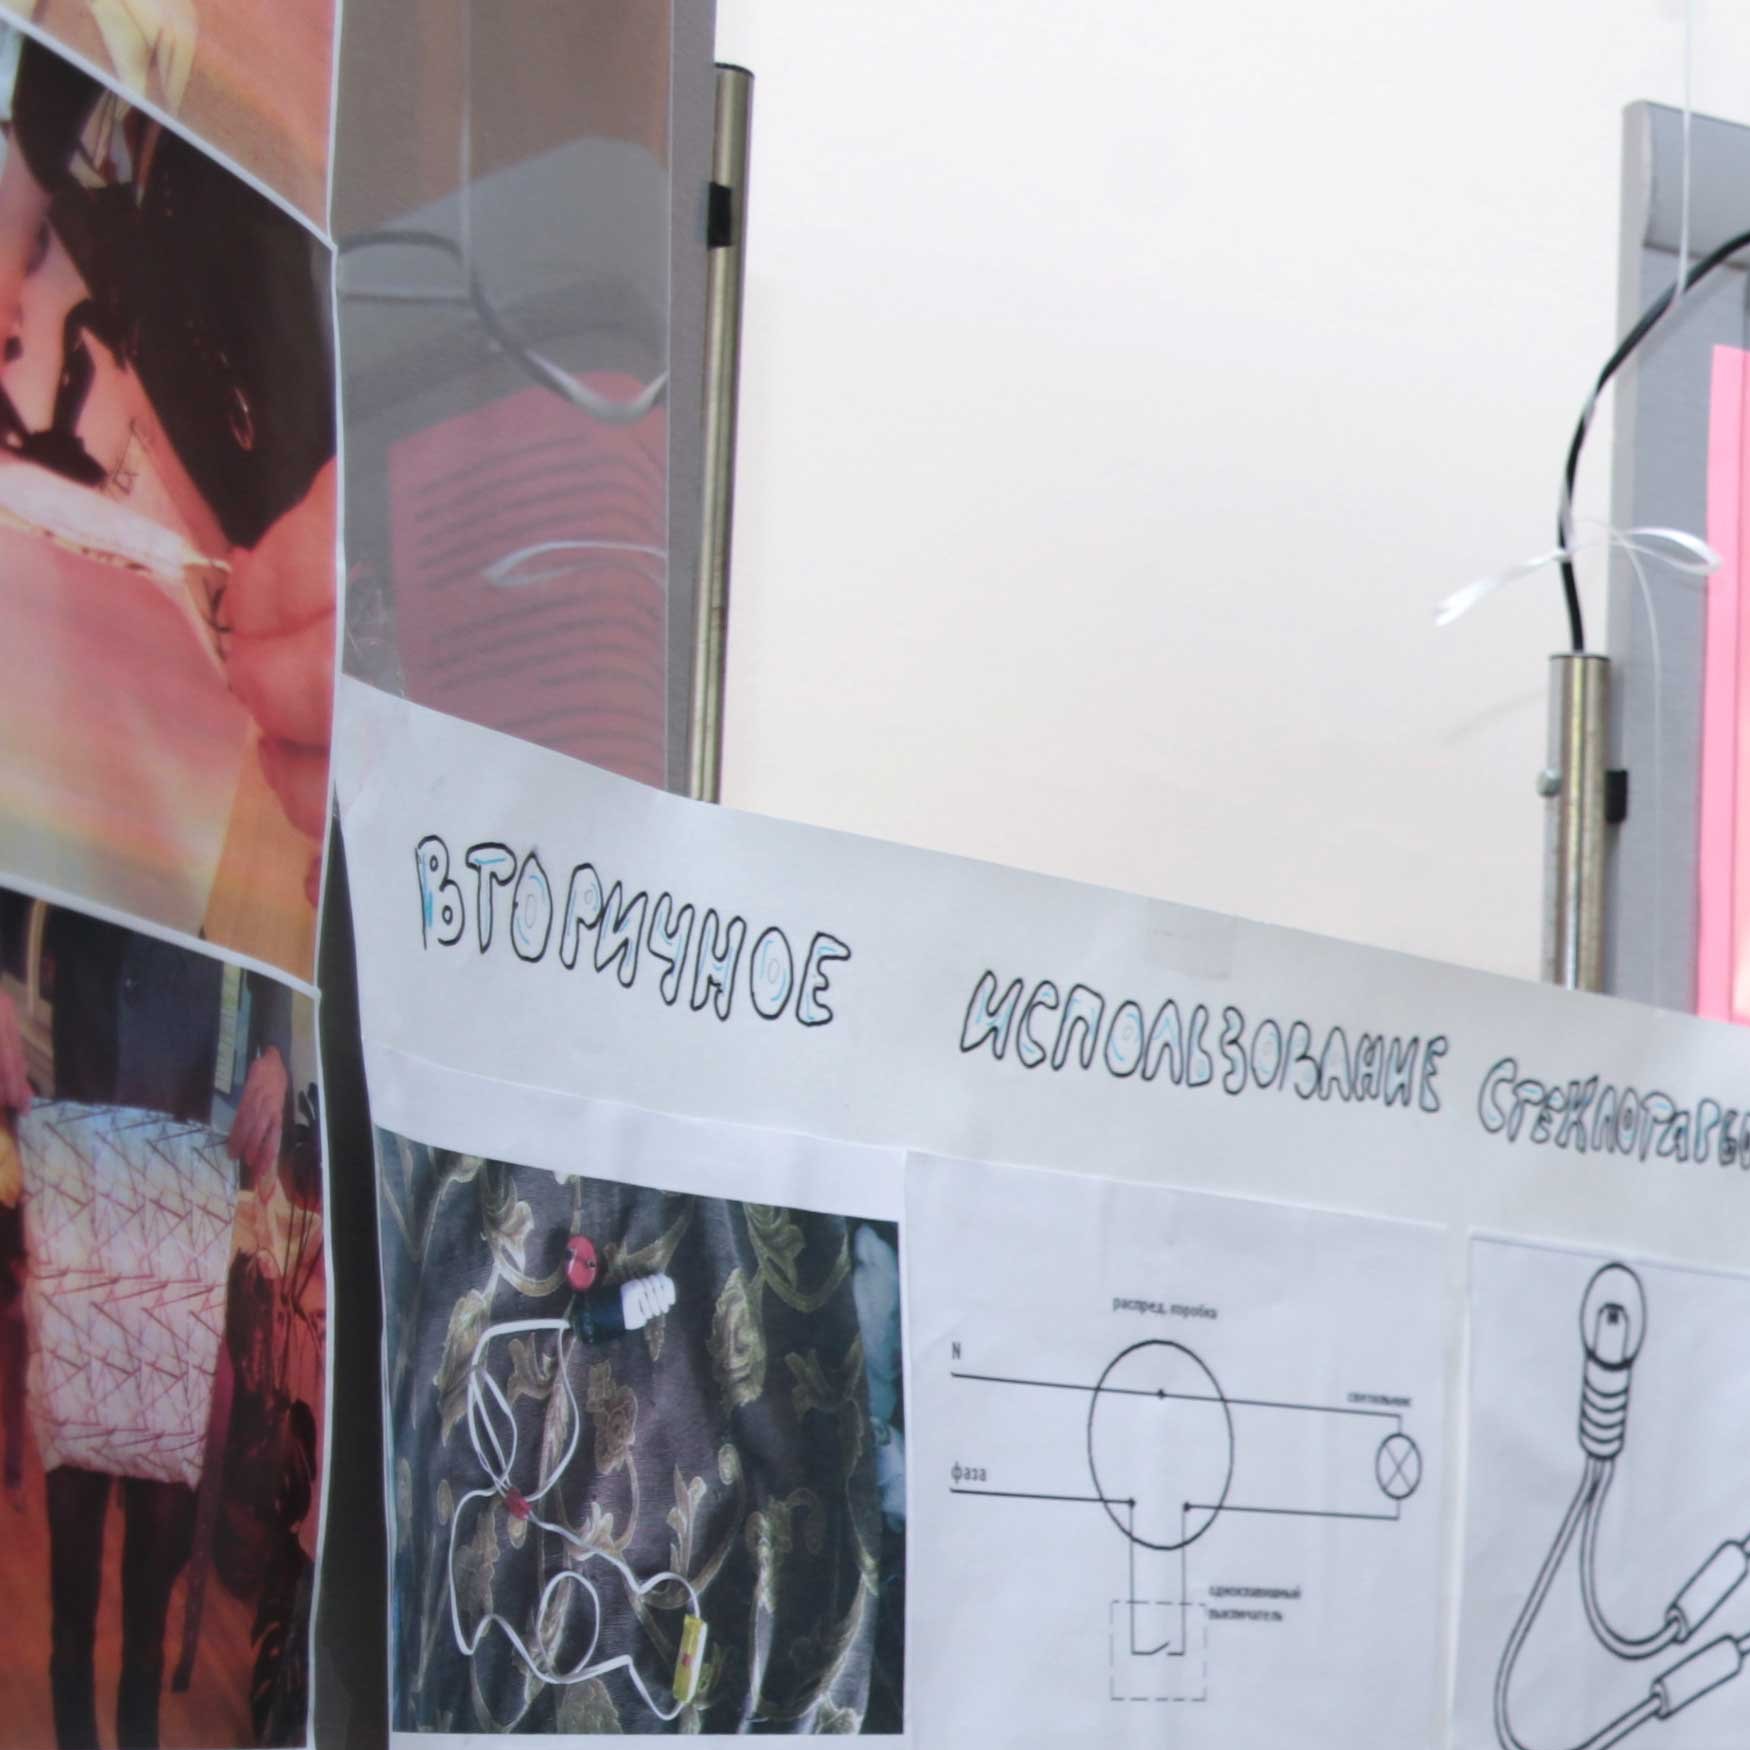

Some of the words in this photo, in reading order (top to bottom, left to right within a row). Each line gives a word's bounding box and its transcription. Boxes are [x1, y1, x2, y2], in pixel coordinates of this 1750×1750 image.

[415, 834, 851, 1026] ВТОРИЧНОЕ
[960, 970, 1448, 1113] ИСПОЛЬЗОВАНИЕ
[951, 1341, 961, 1361] N
[950, 1460, 987, 1485] фаза
